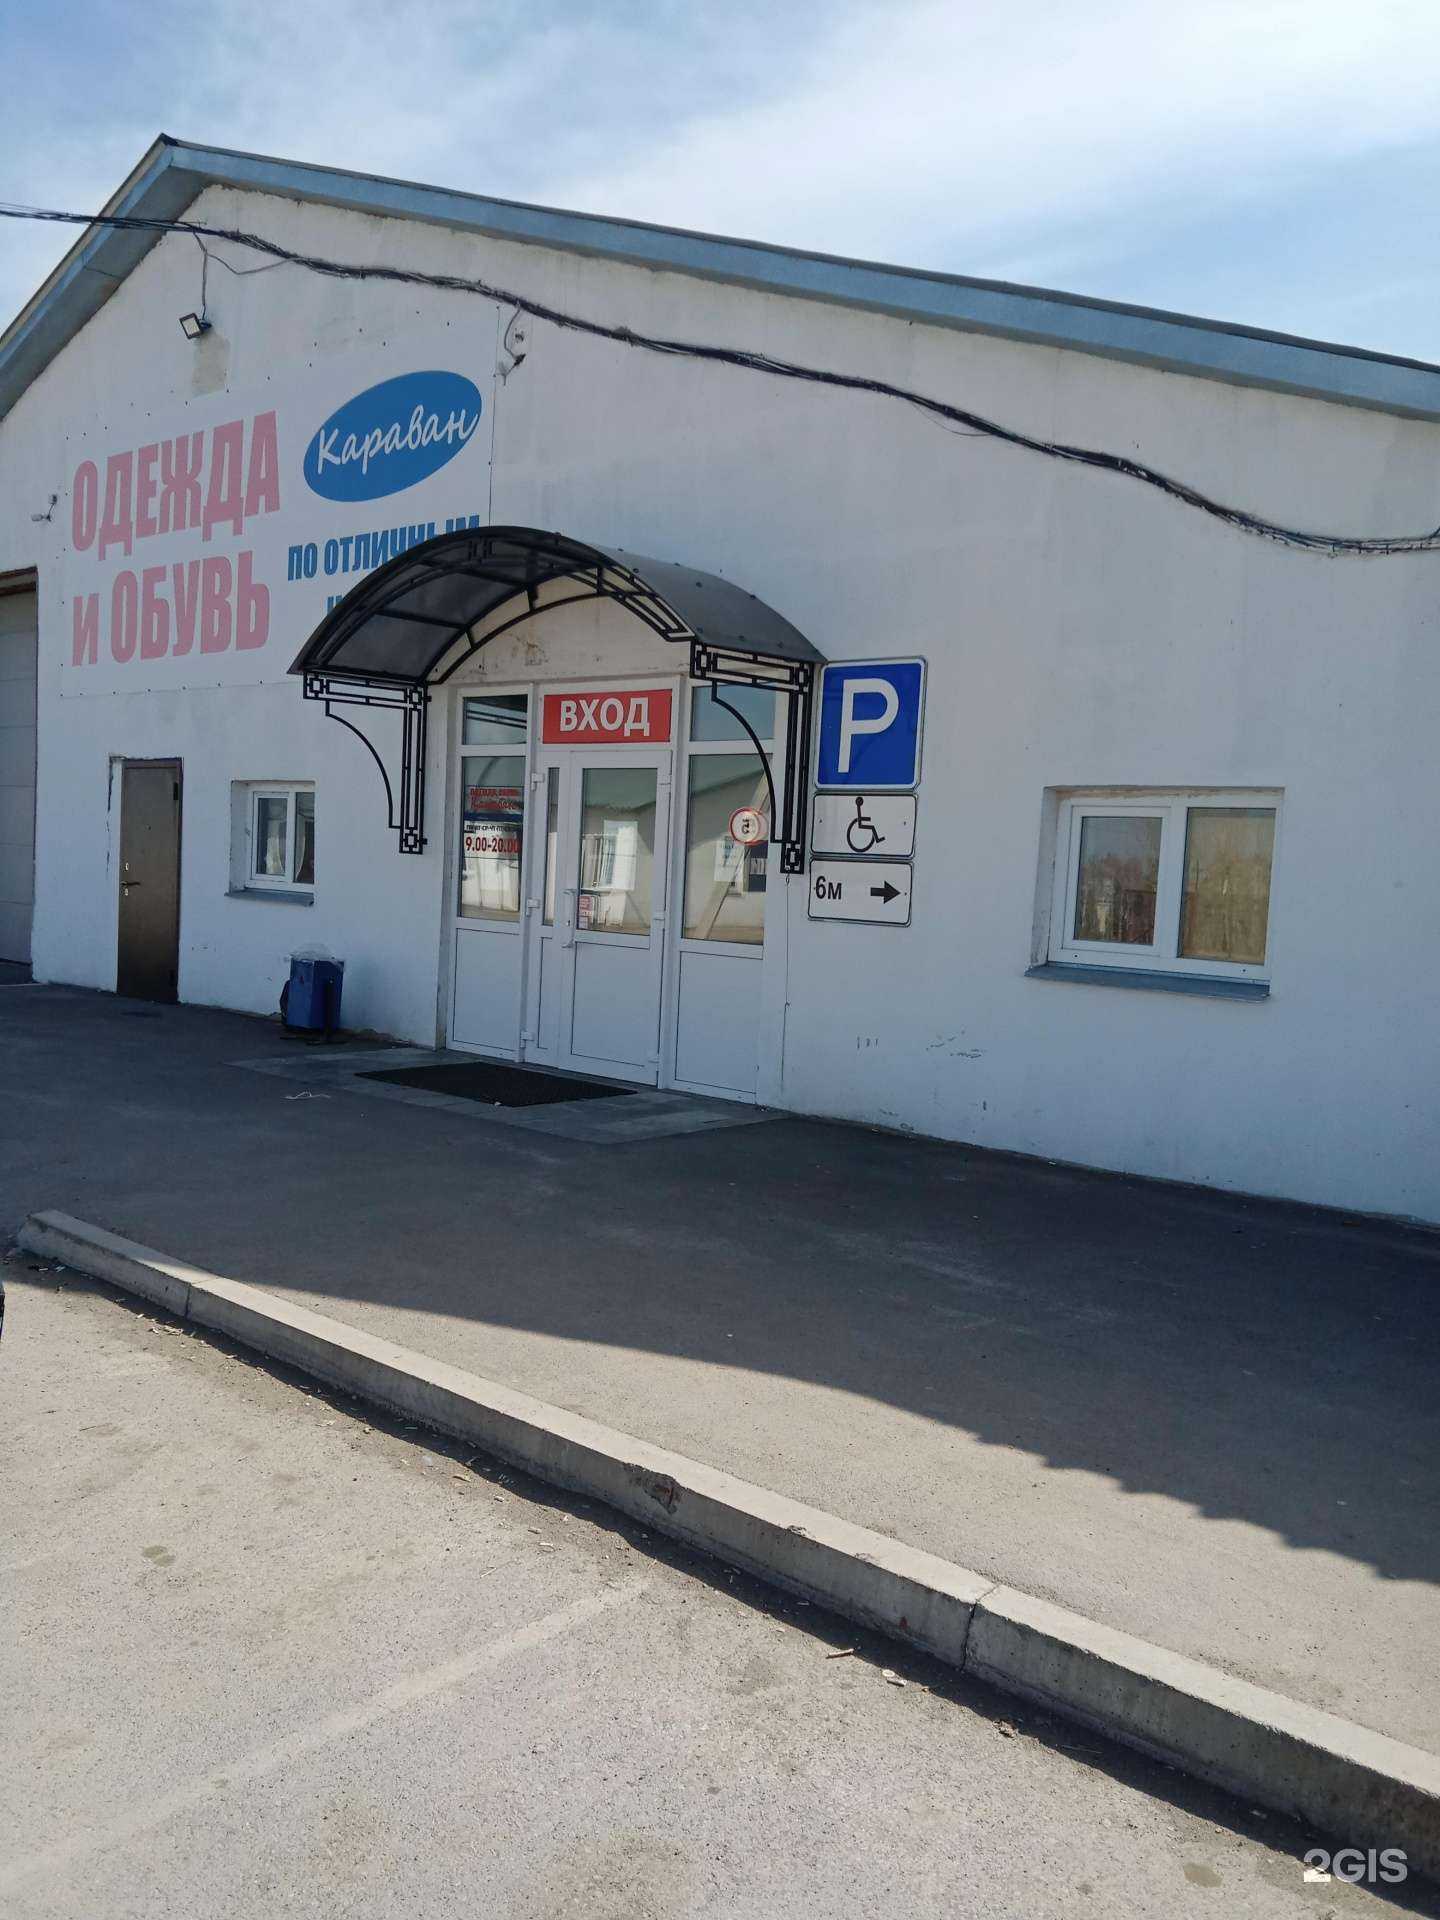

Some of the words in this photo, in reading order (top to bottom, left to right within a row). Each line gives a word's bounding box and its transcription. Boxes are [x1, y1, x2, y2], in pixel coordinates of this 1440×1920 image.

[316, 404, 480, 475] Караван
[71, 410, 281, 561] ОДЕЖДА
[287, 542, 318, 582] ПО
[71, 592, 101, 667] И
[109, 550, 271, 664] ОБУВЬ
[559, 696, 650, 738] ВХОД
[465, 836, 519, 853] 9.00-20.00
